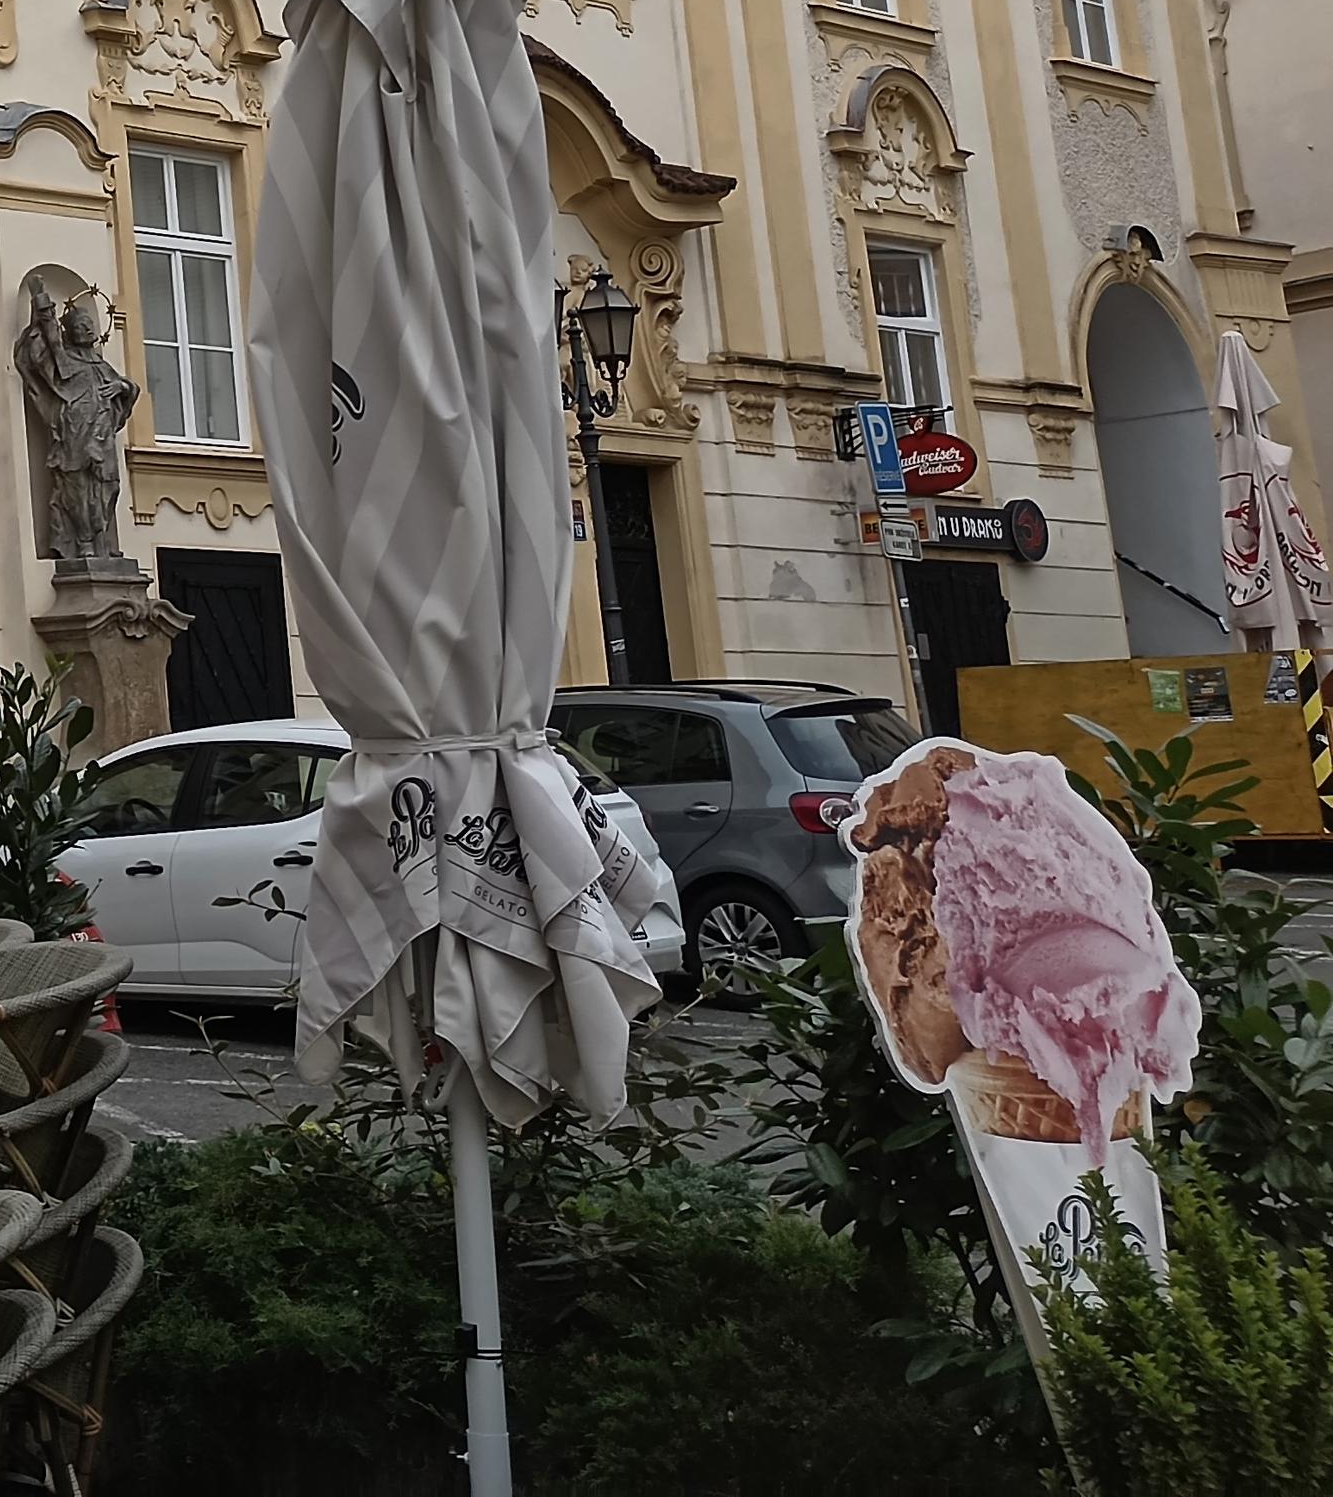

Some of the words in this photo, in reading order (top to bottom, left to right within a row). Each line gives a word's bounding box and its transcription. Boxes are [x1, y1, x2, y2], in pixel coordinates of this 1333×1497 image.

[950, 517, 960, 538] U
[962, 515, 1003, 540] DRAKŮ
[602, 846, 631, 892] ELATO
[473, 884, 528, 918] GELATO
